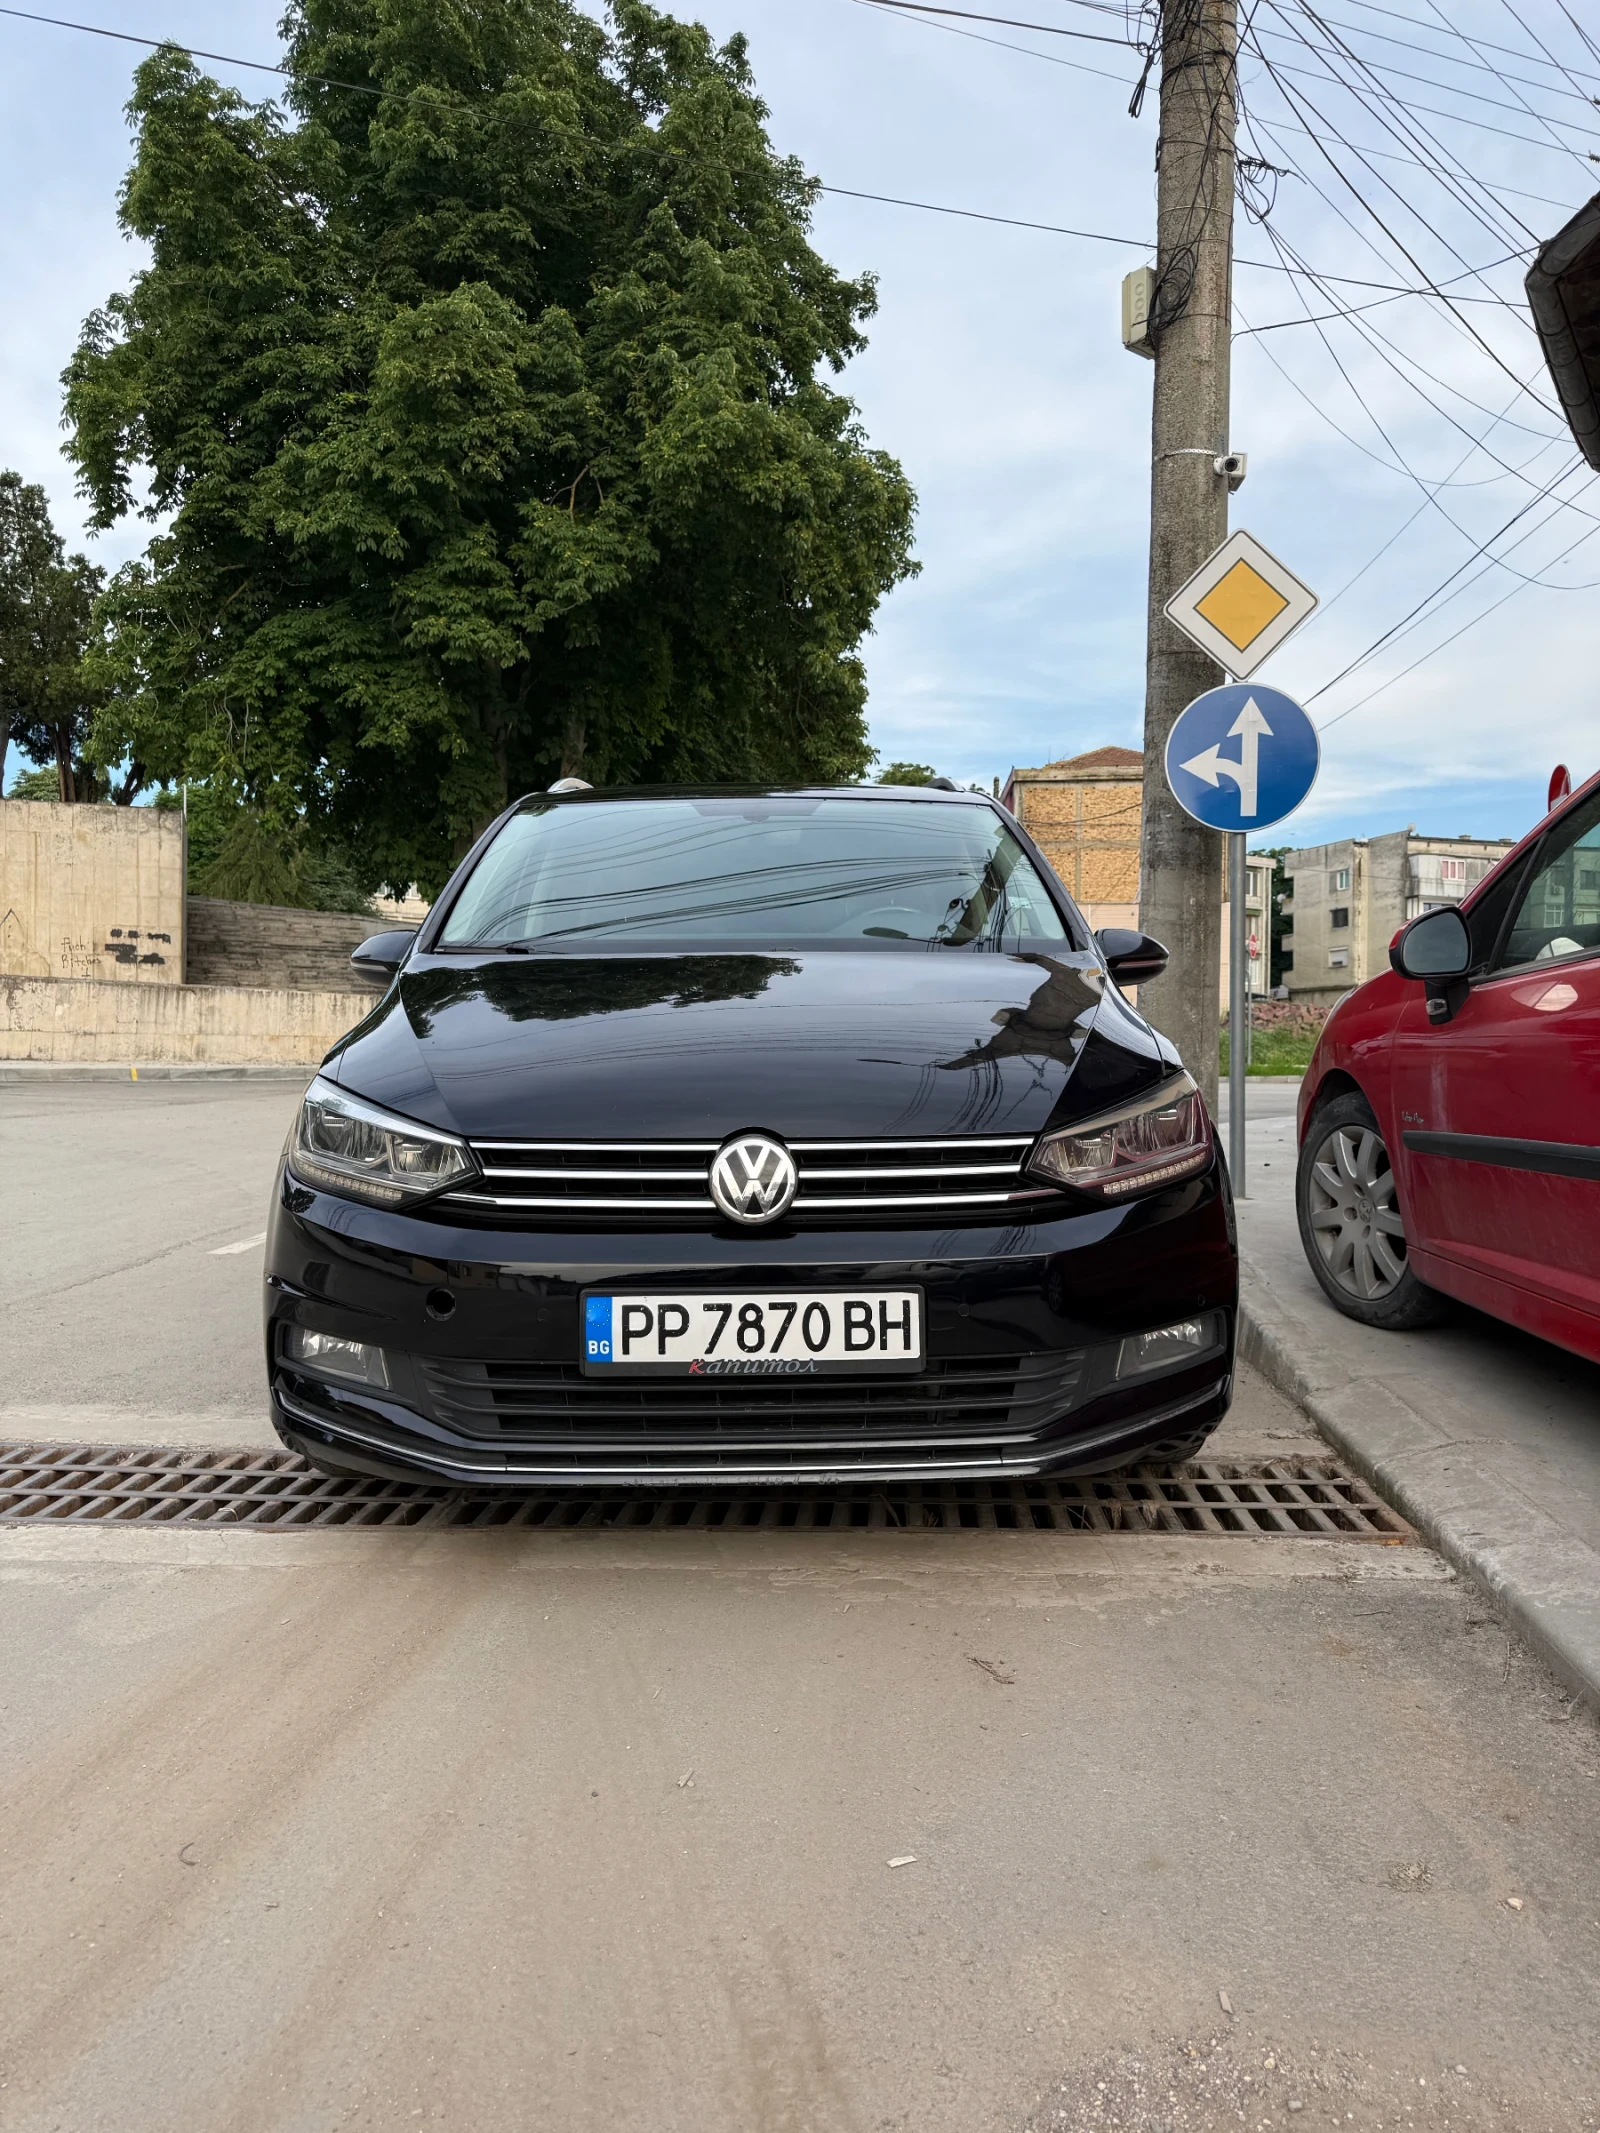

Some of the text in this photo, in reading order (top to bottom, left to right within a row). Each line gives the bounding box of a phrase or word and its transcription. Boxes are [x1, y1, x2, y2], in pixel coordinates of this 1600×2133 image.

[61, 954, 101, 969] Bitches
[711, 1140, 796, 1219] VW
[622, 1300, 911, 1355] PP 7870 BH
[588, 1340, 610, 1354] BG
